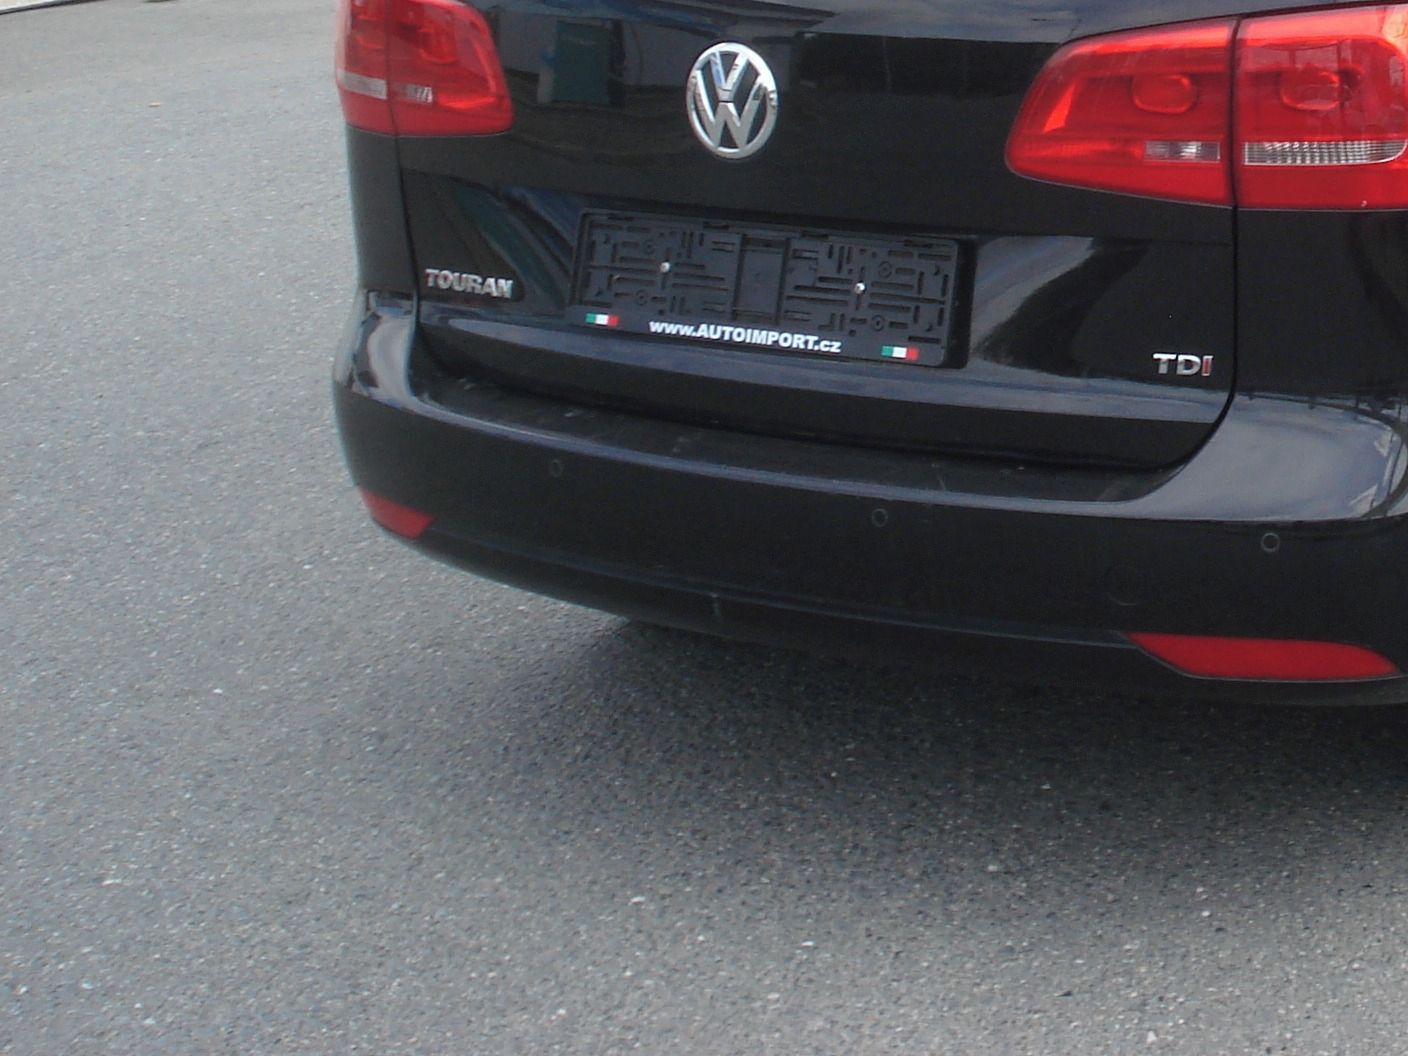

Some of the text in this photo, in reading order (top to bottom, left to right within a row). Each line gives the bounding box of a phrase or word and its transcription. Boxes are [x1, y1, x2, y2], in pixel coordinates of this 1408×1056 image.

[425, 268, 513, 299] TOURAN
[649, 320, 842, 353] www.AUTOIMPORT.cz
[1152, 352, 1214, 377] TDI
